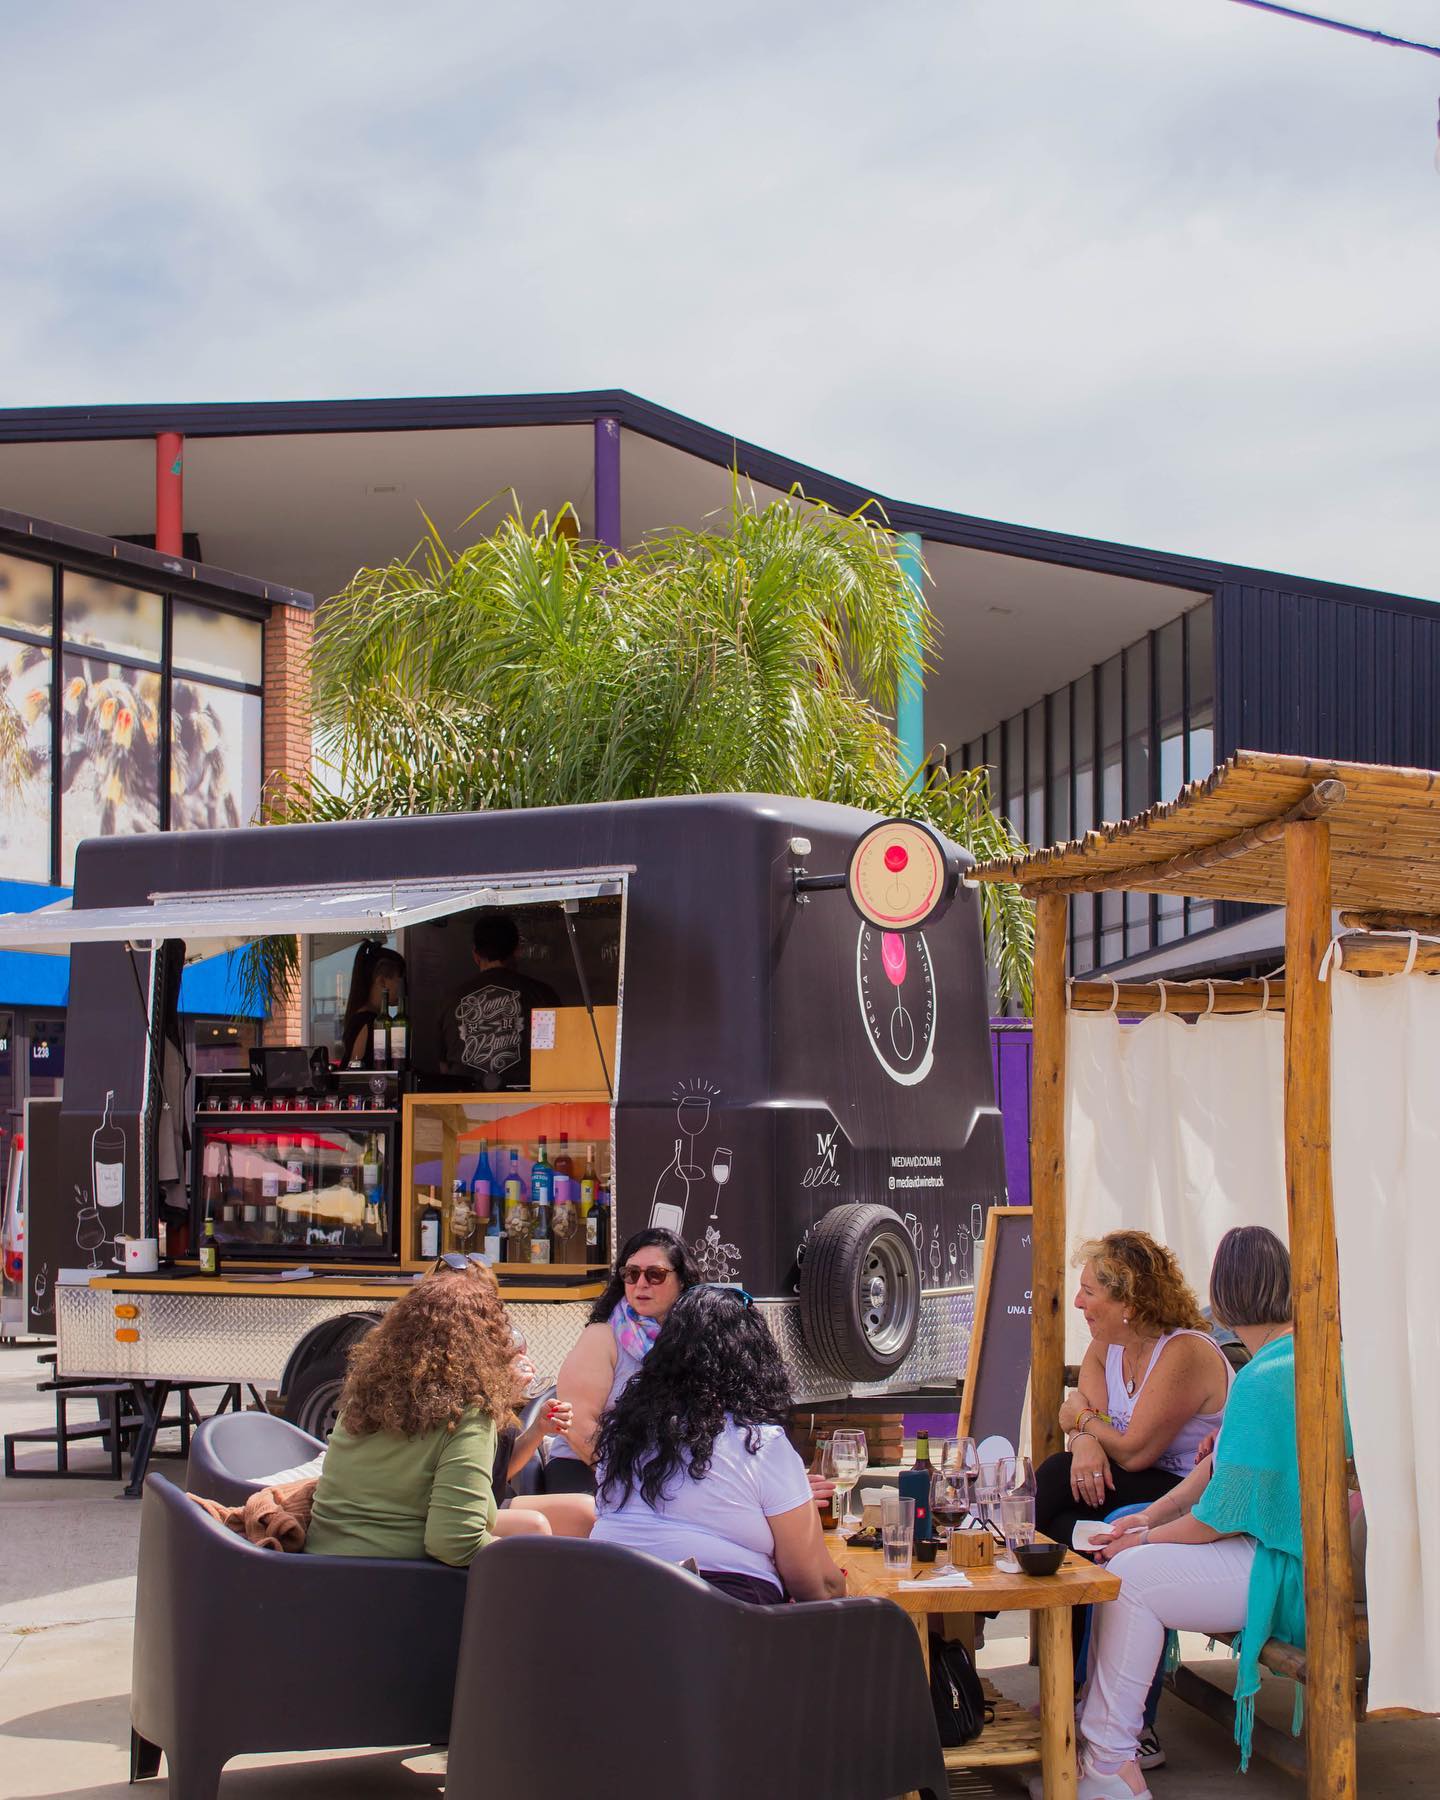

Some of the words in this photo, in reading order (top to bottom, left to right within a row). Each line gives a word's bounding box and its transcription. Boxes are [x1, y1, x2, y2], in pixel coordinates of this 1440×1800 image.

[862, 932, 871, 961] VID
[862, 975, 880, 1039] MEDIA
[1007, 1305, 1026, 1315] UNA
[978, 1542, 985, 1557] 1
